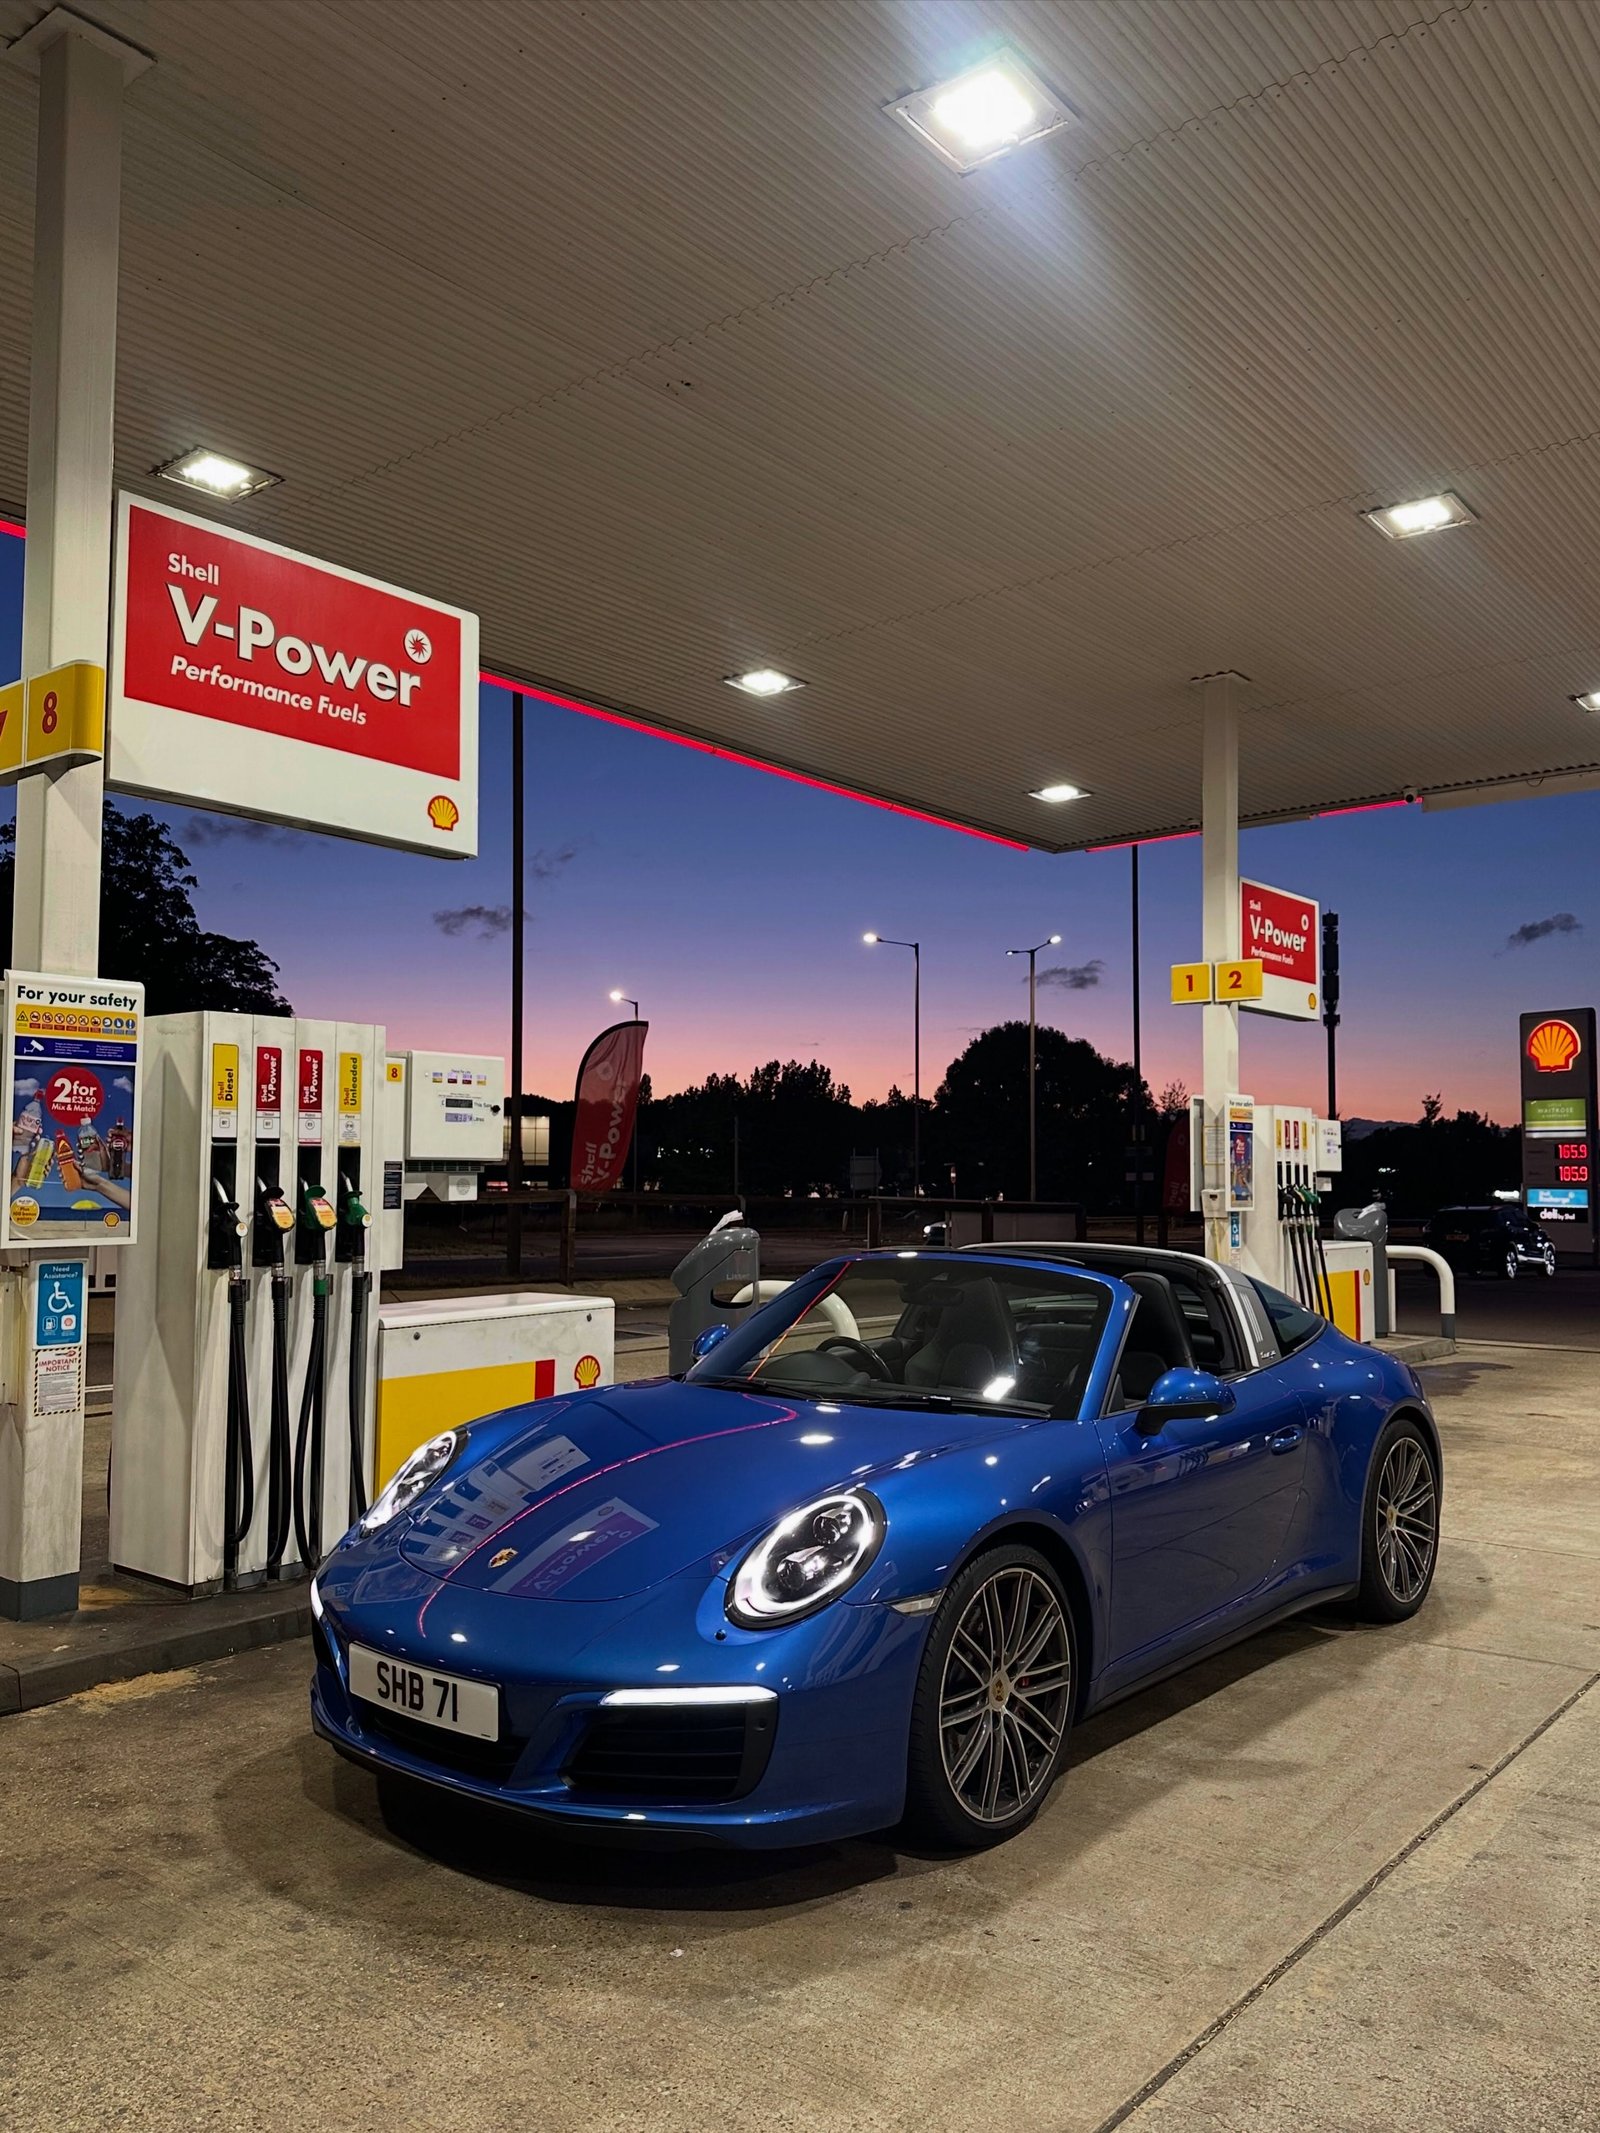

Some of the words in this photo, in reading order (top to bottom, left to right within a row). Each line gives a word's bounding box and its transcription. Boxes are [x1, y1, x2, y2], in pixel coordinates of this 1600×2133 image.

[168, 553, 219, 586] Shell
[166, 582, 421, 707] V-Power
[170, 655, 313, 710] Performance
[317, 695, 367, 725] Fuels
[42, 691, 57, 734] 8
[1249, 899, 1261, 911] Shell
[1249, 914, 1306, 952] V-Power
[1250, 945, 1281, 962] Performance
[1282, 953, 1294, 965] Fuels
[1185, 974, 1194, 992] 1
[1228, 970, 1242, 989] 2
[17, 985, 44, 1000] For
[49, 991, 86, 1004] your
[90, 993, 137, 1011] safety
[225, 1068, 234, 1101] Diesel
[268, 1056, 277, 1102] V-Power
[310, 1058, 318, 1104] V-Power
[350, 1057, 358, 1106] Unleaded
[391, 1067, 398, 1078] 8
[53, 1077, 72, 1103] 2
[73, 1080, 97, 1096] for
[72, 1095, 97, 1105] £3.50
[52, 1103, 65, 1111] Mix
[581, 1142, 597, 1185] Shell
[1558, 1144, 1587, 1159] 165.9
[1540, 1208, 1558, 1220] deli
[39, 1358, 78, 1367] IMPORTANT
[377, 1661, 424, 1711] SHB
[432, 1677, 458, 1722] 71
